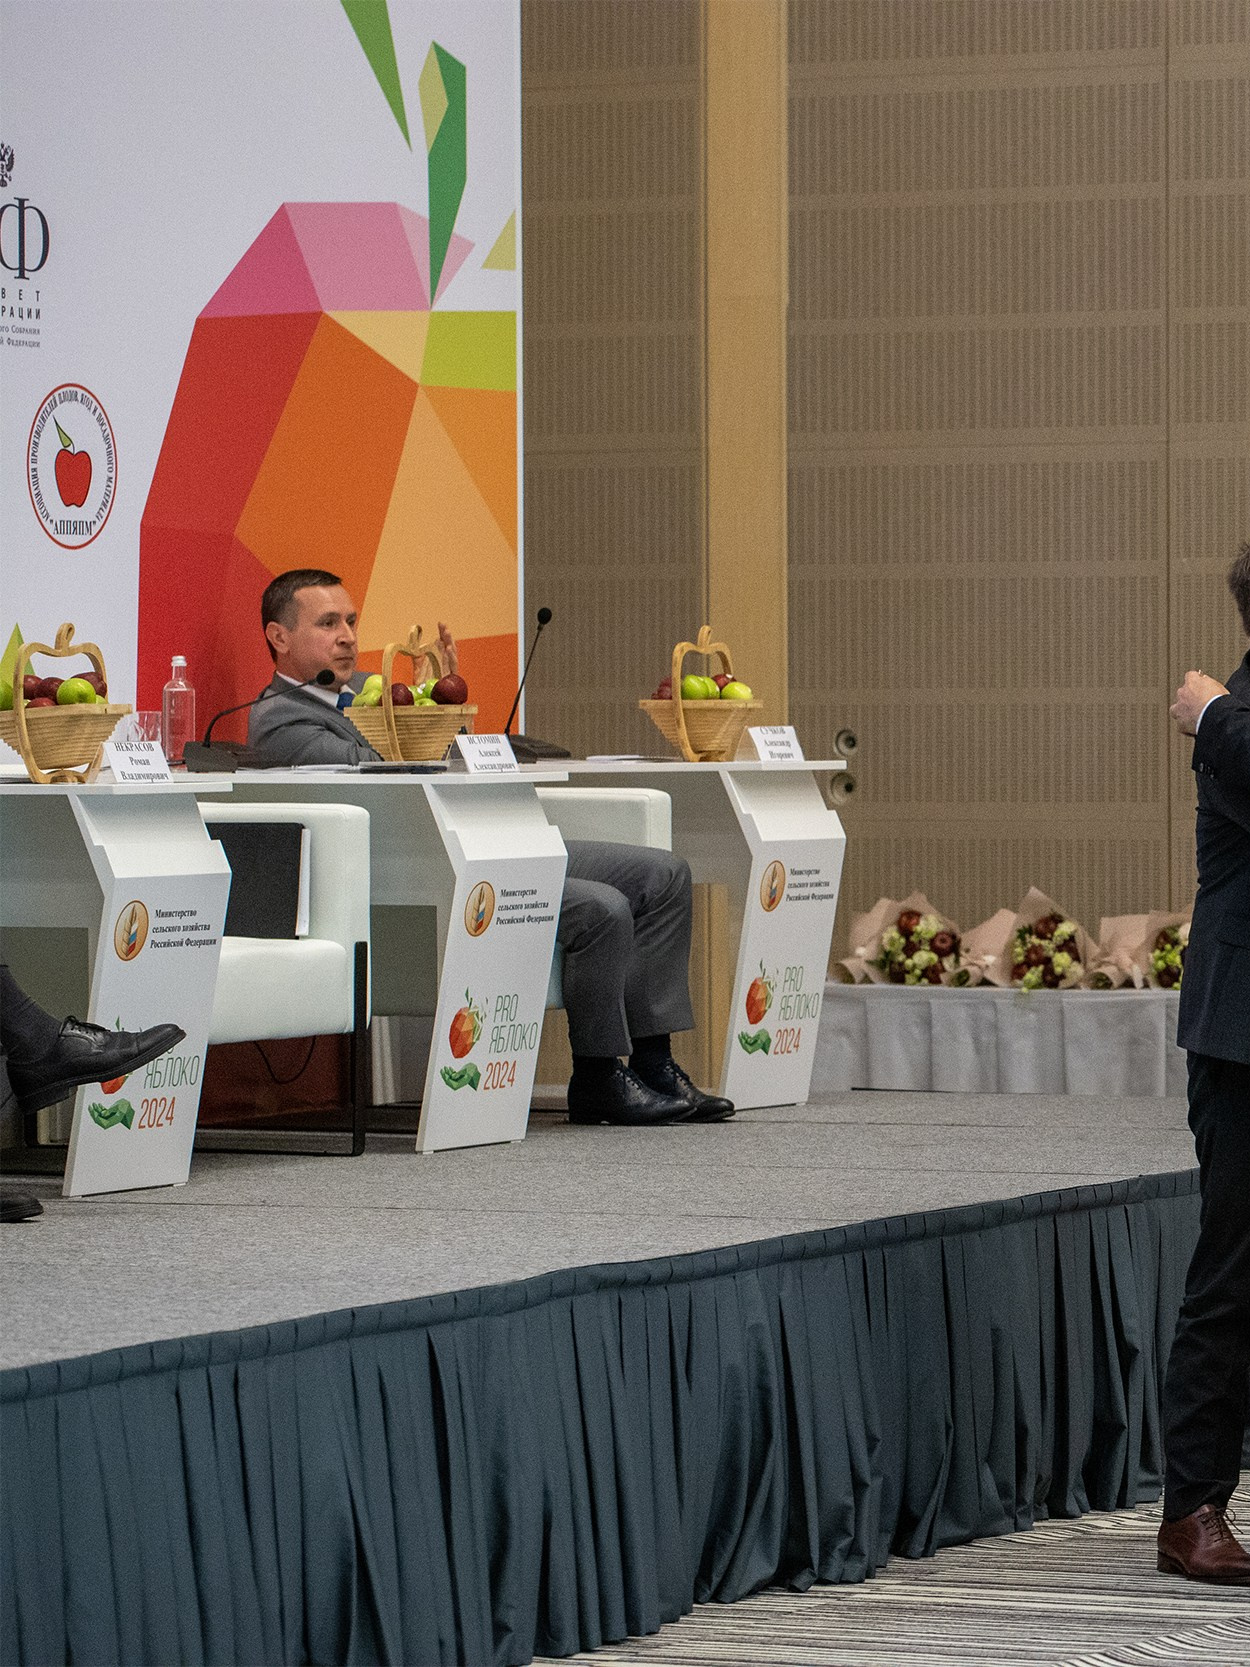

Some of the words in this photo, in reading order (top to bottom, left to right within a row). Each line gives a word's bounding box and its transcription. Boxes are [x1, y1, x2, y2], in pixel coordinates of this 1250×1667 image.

[114, 742, 155, 752] НЕКРАСОВ
[128, 756, 151, 766] Роман
[120, 770, 169, 783] Владимирович
[500, 888, 537, 898] Министерство
[498, 903, 523, 911] сельского
[524, 901, 549, 910] хозяйства
[155, 909, 197, 919] Министерство
[496, 916, 526, 925] Российской
[526, 914, 554, 924] Федерации
[152, 925, 181, 934] сельского
[182, 923, 211, 933] хозяйства
[150, 939, 184, 949] Российской
[185, 938, 217, 947] Федерации
[782, 966, 804, 992] PRO
[493, 994, 519, 1023] PRO
[778, 992, 820, 1021] ЯБЛОКО
[489, 1022, 539, 1054] ЯБЛОКО
[773, 1027, 802, 1055] 2024
[143, 1055, 200, 1089] ЯБЛОКО
[483, 1060, 517, 1091] 2024
[138, 1097, 176, 1129] 2024
